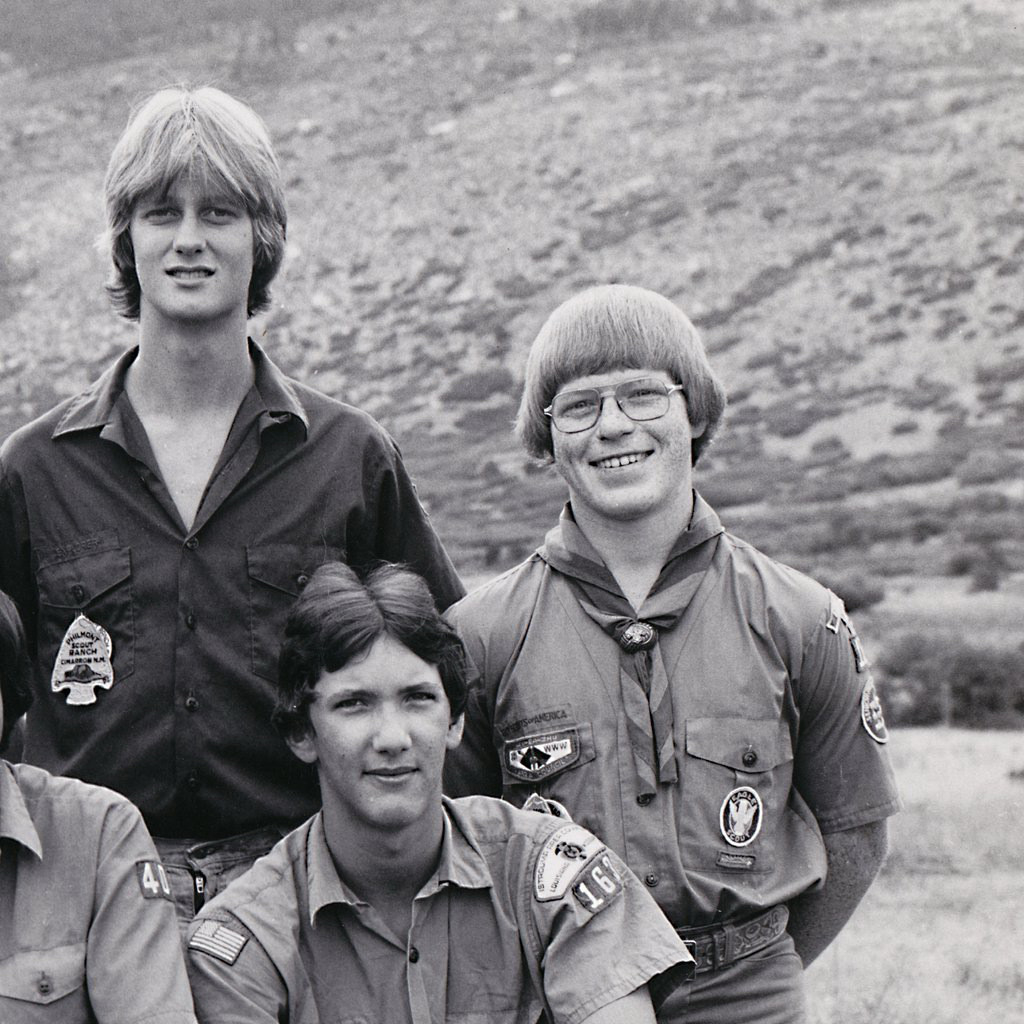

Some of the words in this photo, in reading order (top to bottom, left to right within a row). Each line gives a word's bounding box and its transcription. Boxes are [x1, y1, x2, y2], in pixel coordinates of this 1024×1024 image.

[66, 631, 100, 646] PHILMONT
[544, 741, 568, 753] WWW
[731, 790, 757, 806] EAGLE
[726, 828, 750, 842] SCOUT
